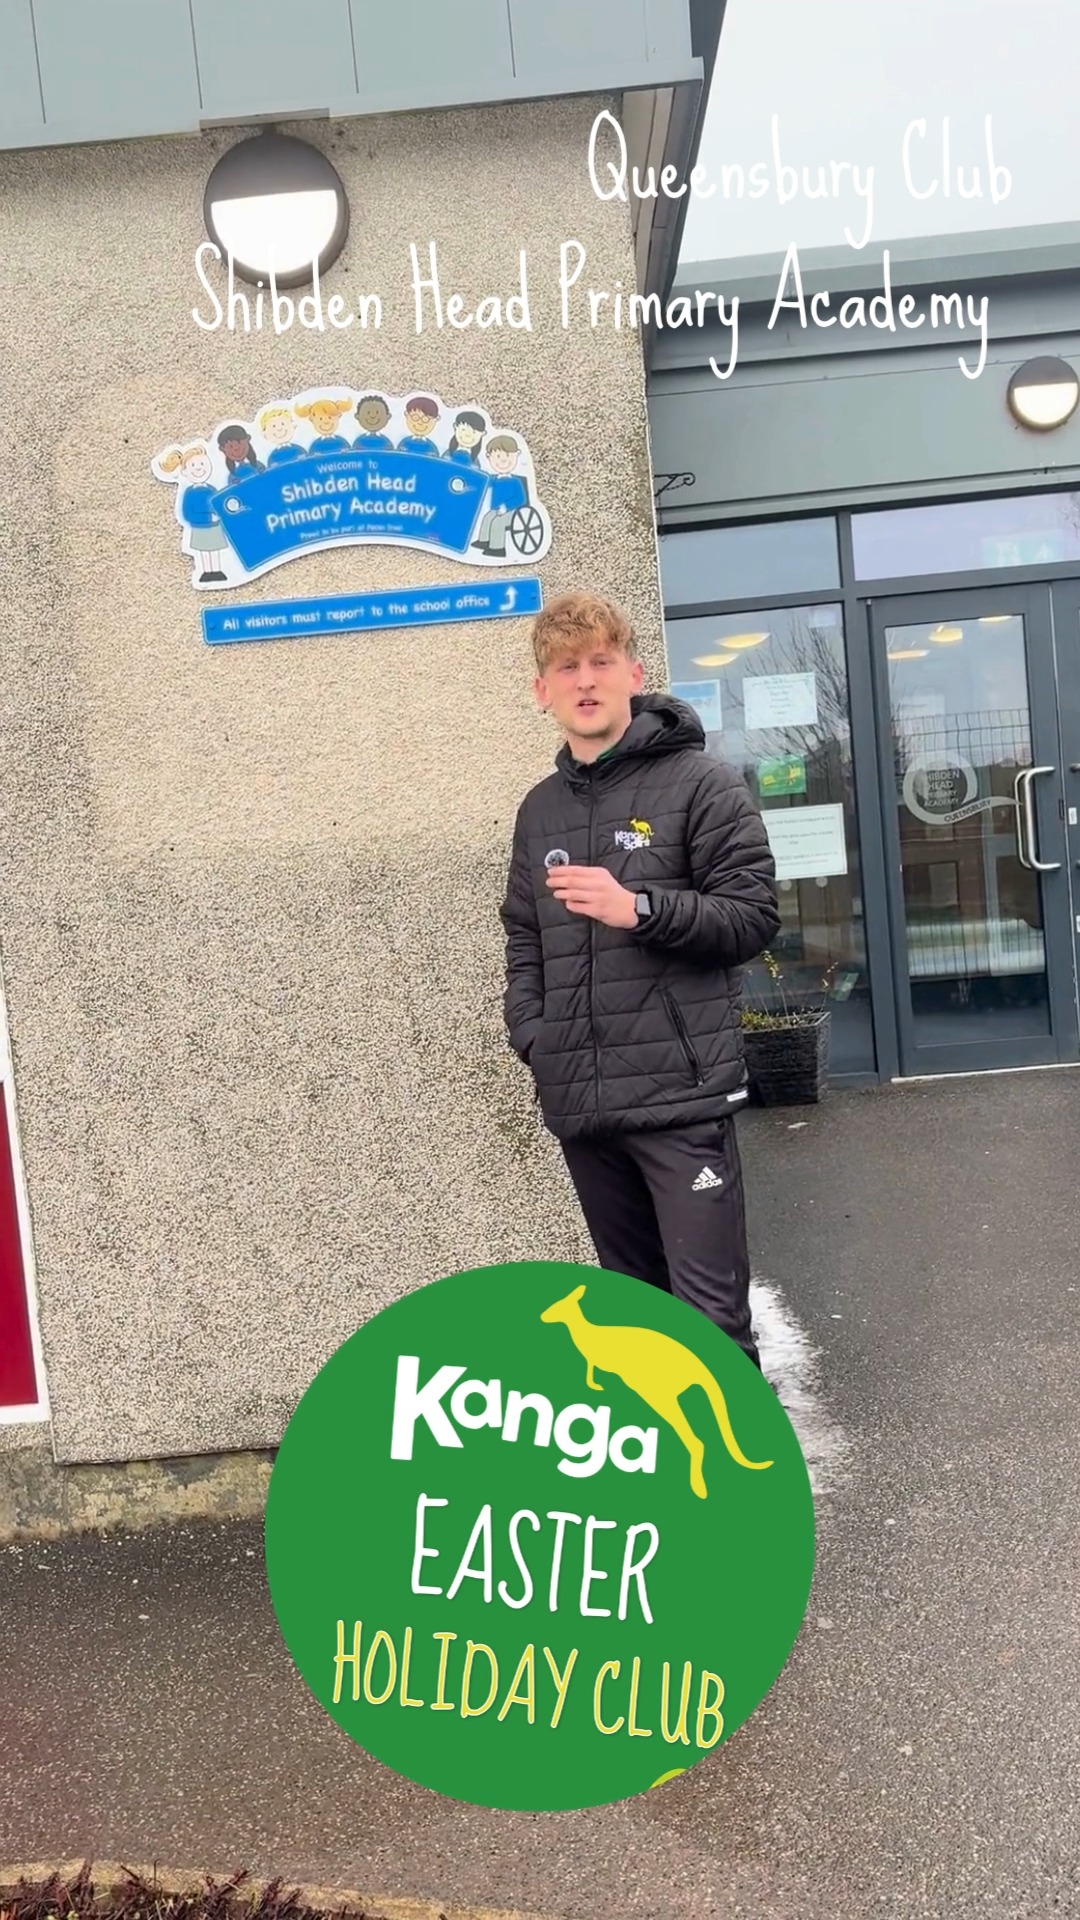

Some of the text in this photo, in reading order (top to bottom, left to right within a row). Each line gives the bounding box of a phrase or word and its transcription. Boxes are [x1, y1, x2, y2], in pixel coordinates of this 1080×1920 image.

[317, 459, 379, 474] Welcome to
[281, 472, 417, 503] Shibden Head
[266, 497, 436, 533] Primary Academy
[223, 594, 490, 630] All visitors must report to the school office
[922, 770, 960, 781] HIBDEN
[928, 781, 954, 790] HEAD
[923, 799, 960, 808] ACADEMY
[944, 800, 991, 822] QUEENSBURY
[692, 1178, 723, 1191] adidas
